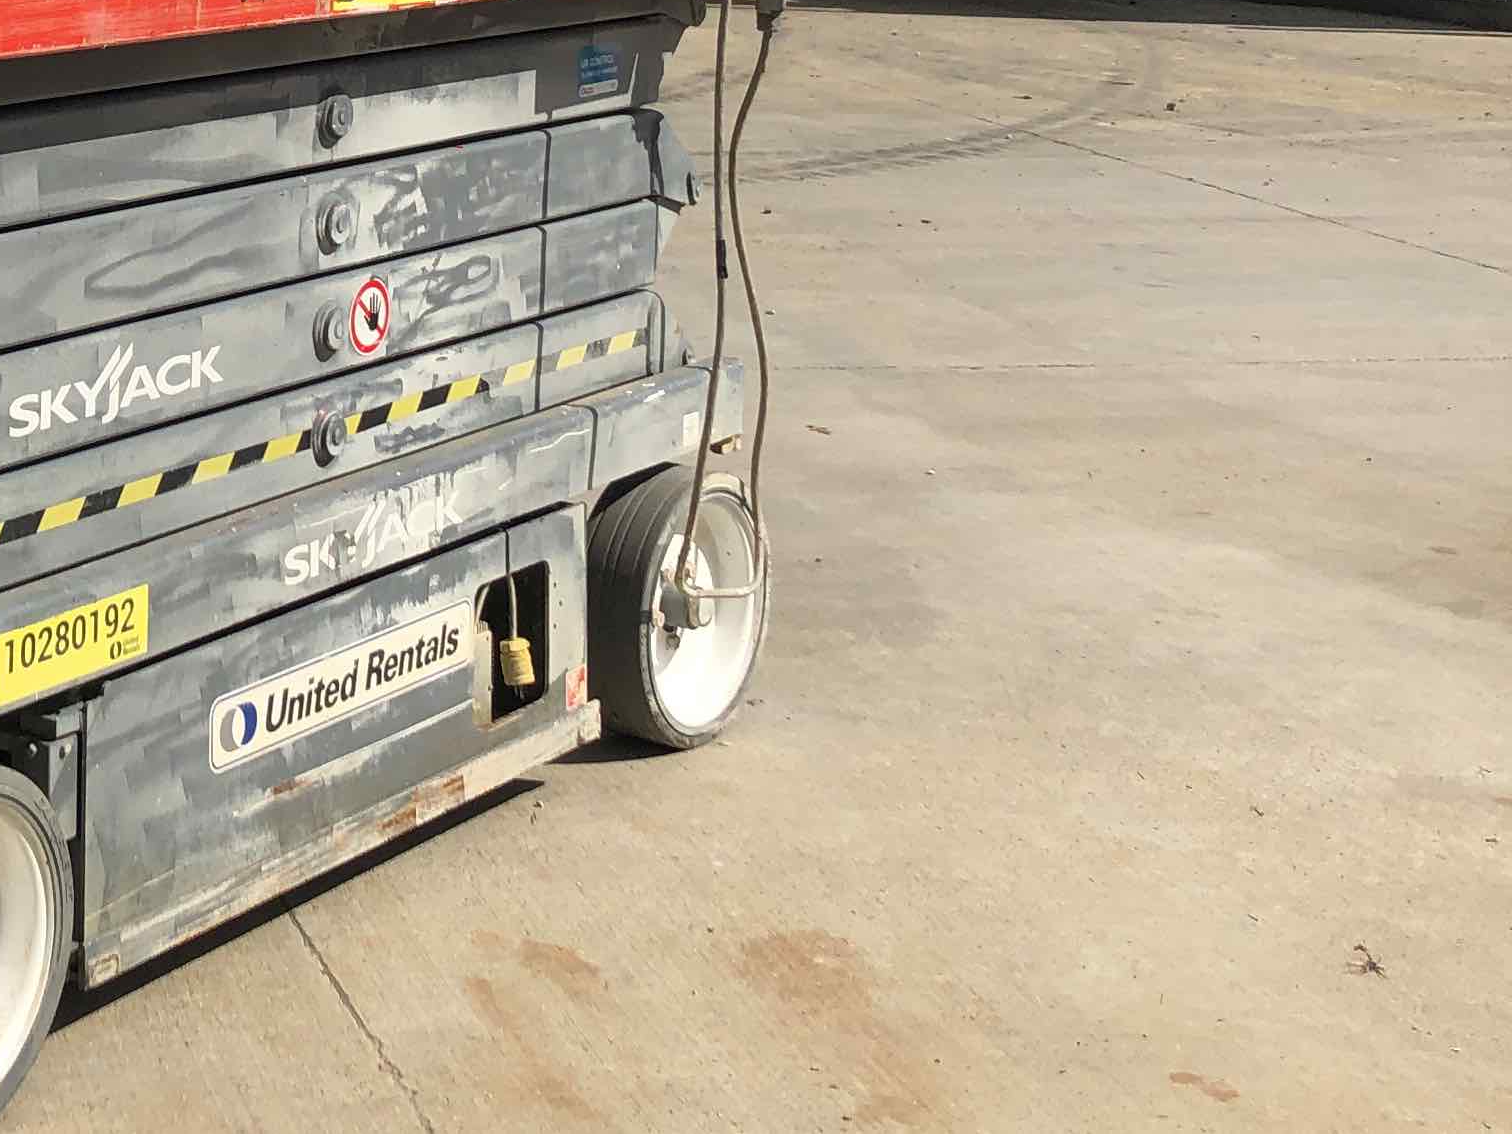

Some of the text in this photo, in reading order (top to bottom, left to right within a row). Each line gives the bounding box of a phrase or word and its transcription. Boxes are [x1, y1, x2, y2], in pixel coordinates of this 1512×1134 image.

[8, 342, 224, 438] SKYJACK
[5, 597, 135, 674] 10280192
[265, 622, 460, 733] United Rentals
